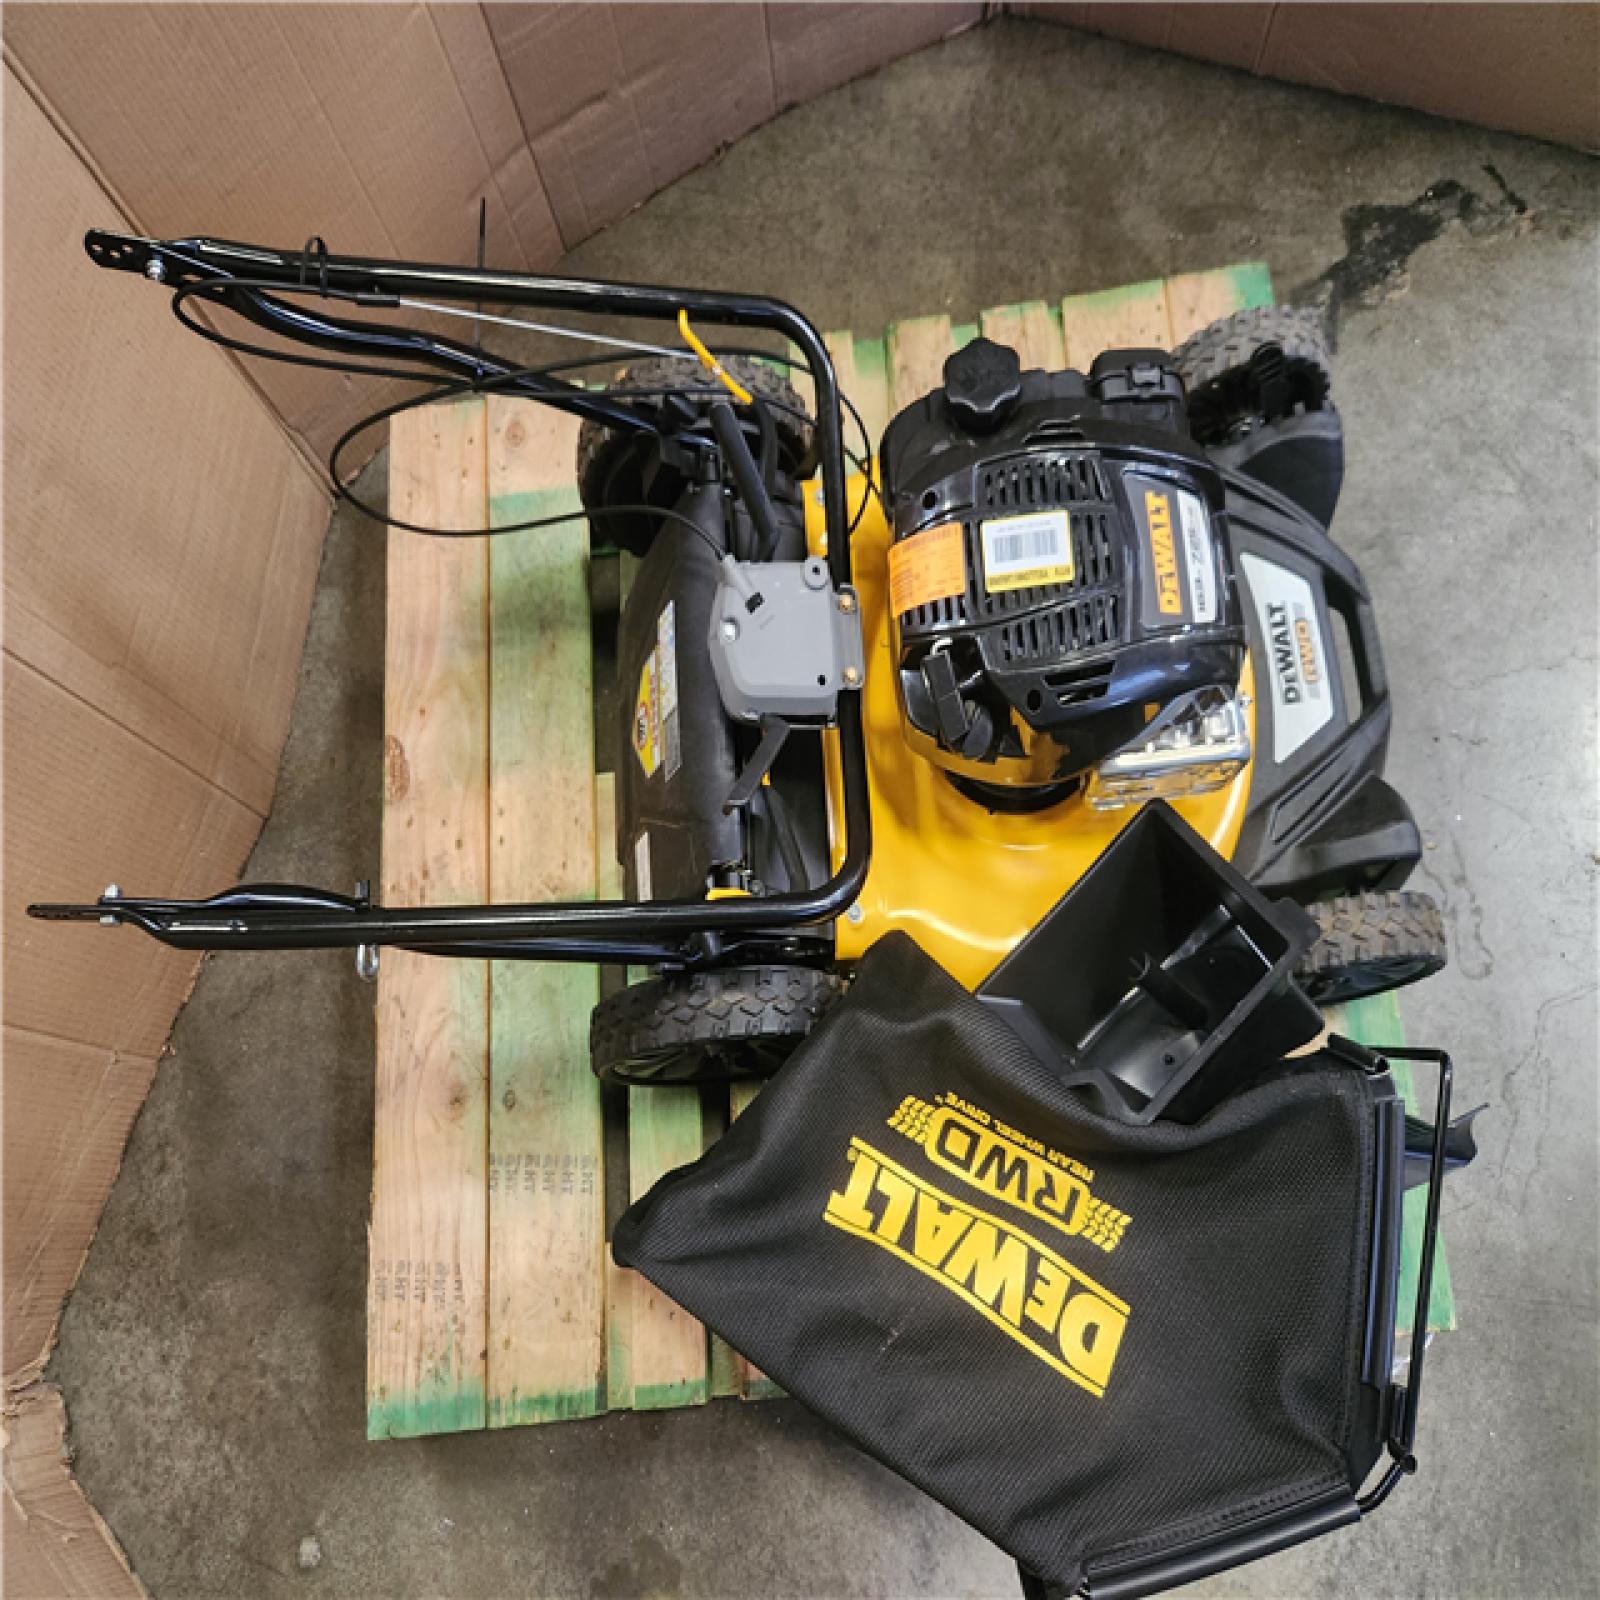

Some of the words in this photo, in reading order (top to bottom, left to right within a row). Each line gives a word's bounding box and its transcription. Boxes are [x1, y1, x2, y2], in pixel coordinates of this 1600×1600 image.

[1144, 491, 1184, 615] DEWALT
[1265, 602, 1301, 705] DEWALT
[934, 1118, 1082, 1225] RWD
[825, 1149, 1129, 1391] DEWALT
